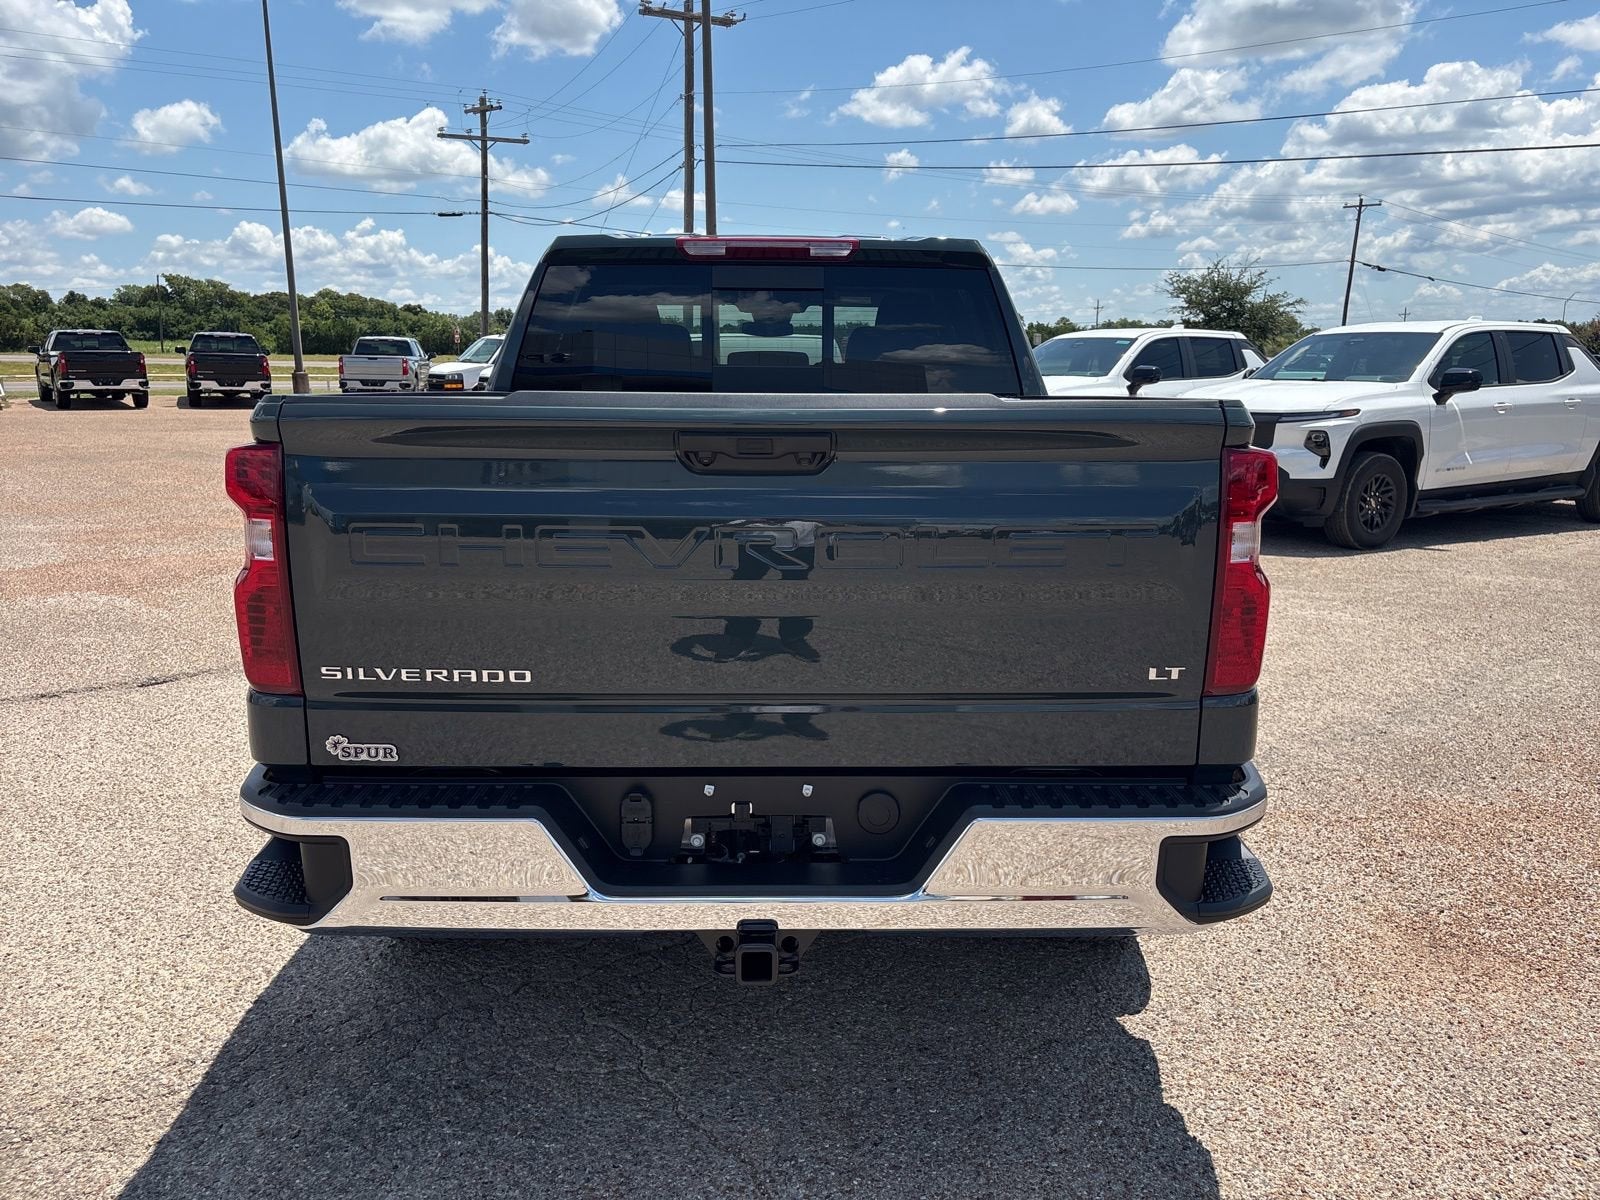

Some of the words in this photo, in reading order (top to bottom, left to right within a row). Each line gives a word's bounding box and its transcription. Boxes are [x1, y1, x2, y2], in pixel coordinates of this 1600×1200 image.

[348, 523, 1160, 570] CHEVROLET
[320, 666, 533, 683] SILVERADO
[1149, 667, 1186, 680] LT
[340, 745, 397, 760] SPUR
